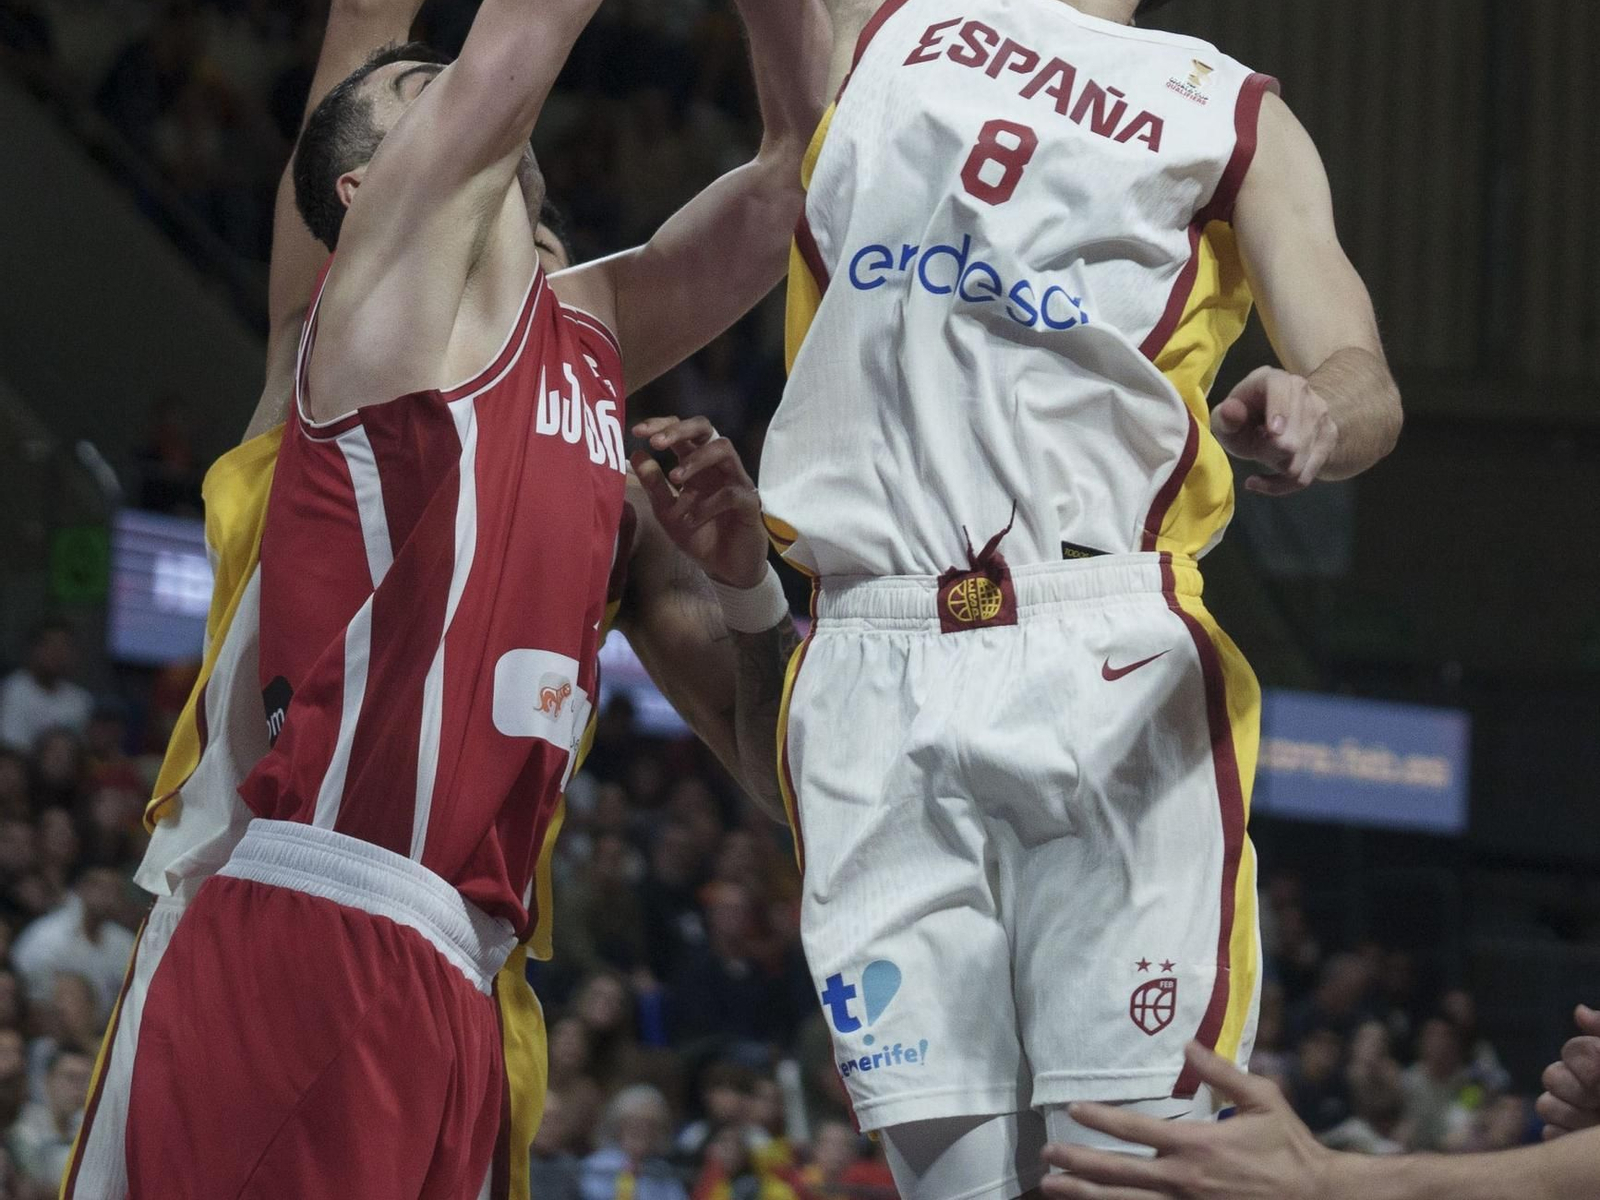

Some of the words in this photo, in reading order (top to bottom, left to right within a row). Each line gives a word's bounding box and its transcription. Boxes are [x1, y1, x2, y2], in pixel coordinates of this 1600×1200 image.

[902, 16, 1164, 153] ESPAÑA
[960, 119, 1038, 206] 8
[841, 1038, 929, 1078] enerife!
